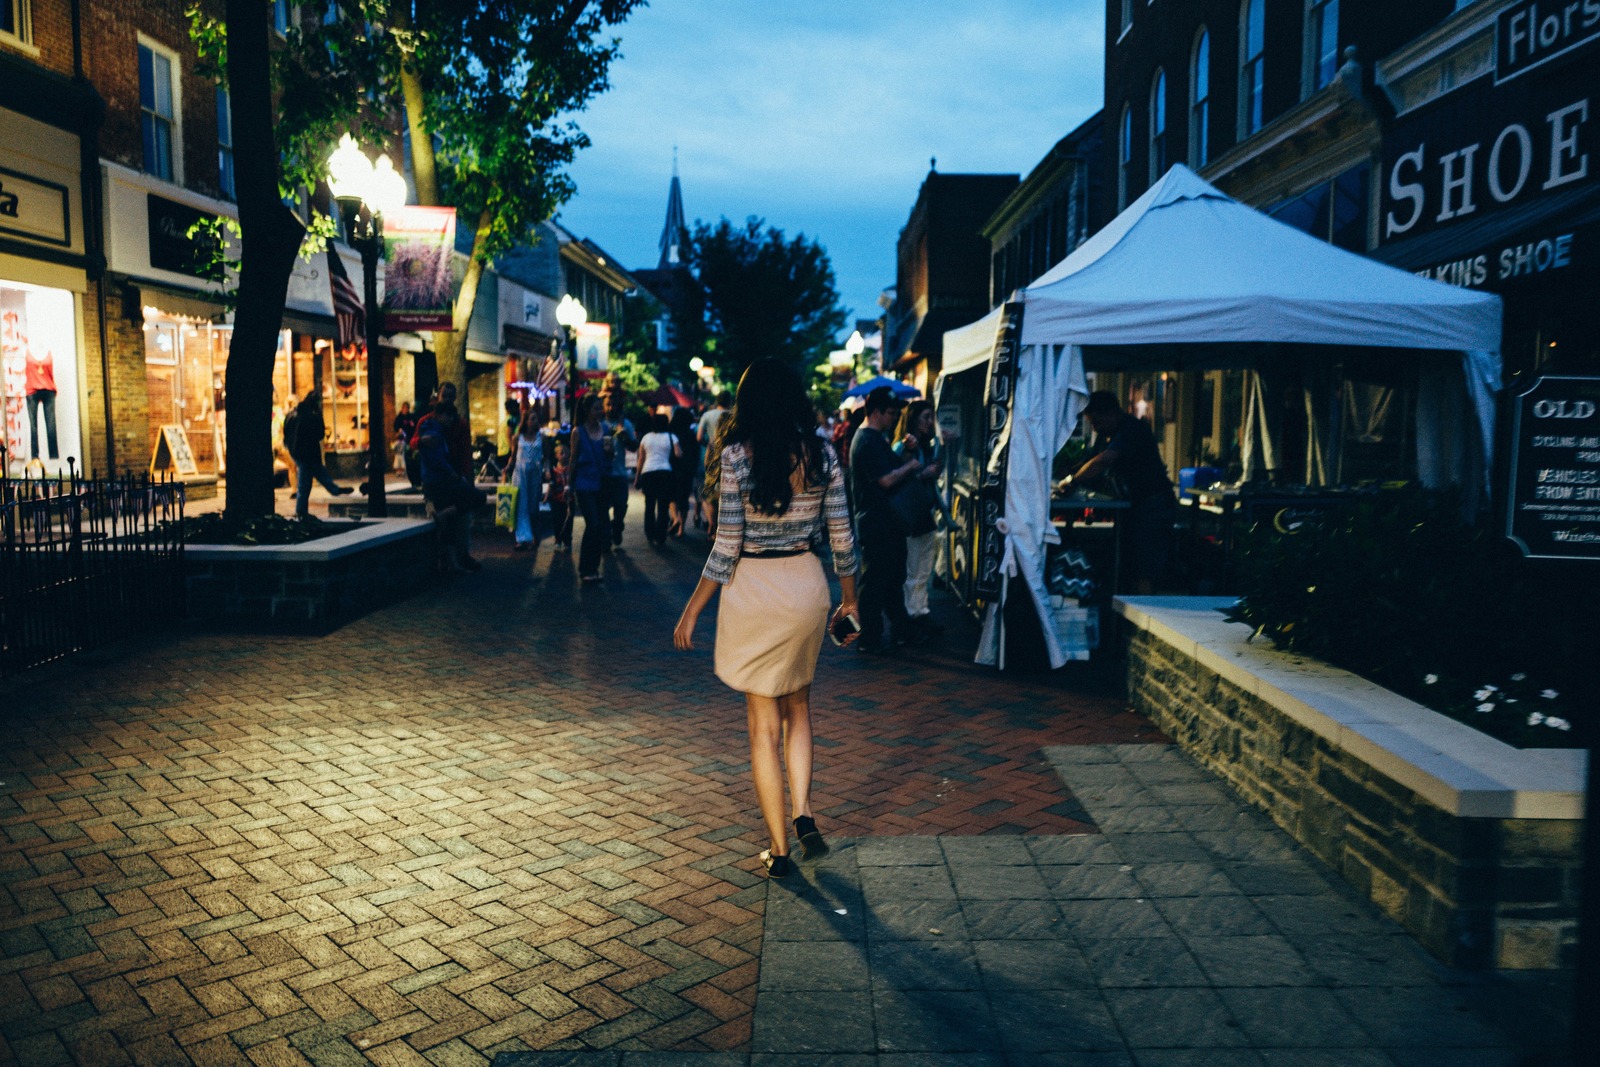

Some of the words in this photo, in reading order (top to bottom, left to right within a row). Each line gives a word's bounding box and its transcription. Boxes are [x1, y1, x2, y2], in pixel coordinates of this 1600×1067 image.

[1386, 98, 1589, 239] SHOE
[1499, 232, 1575, 280] SHOE
[1533, 399, 1596, 418] OLD
